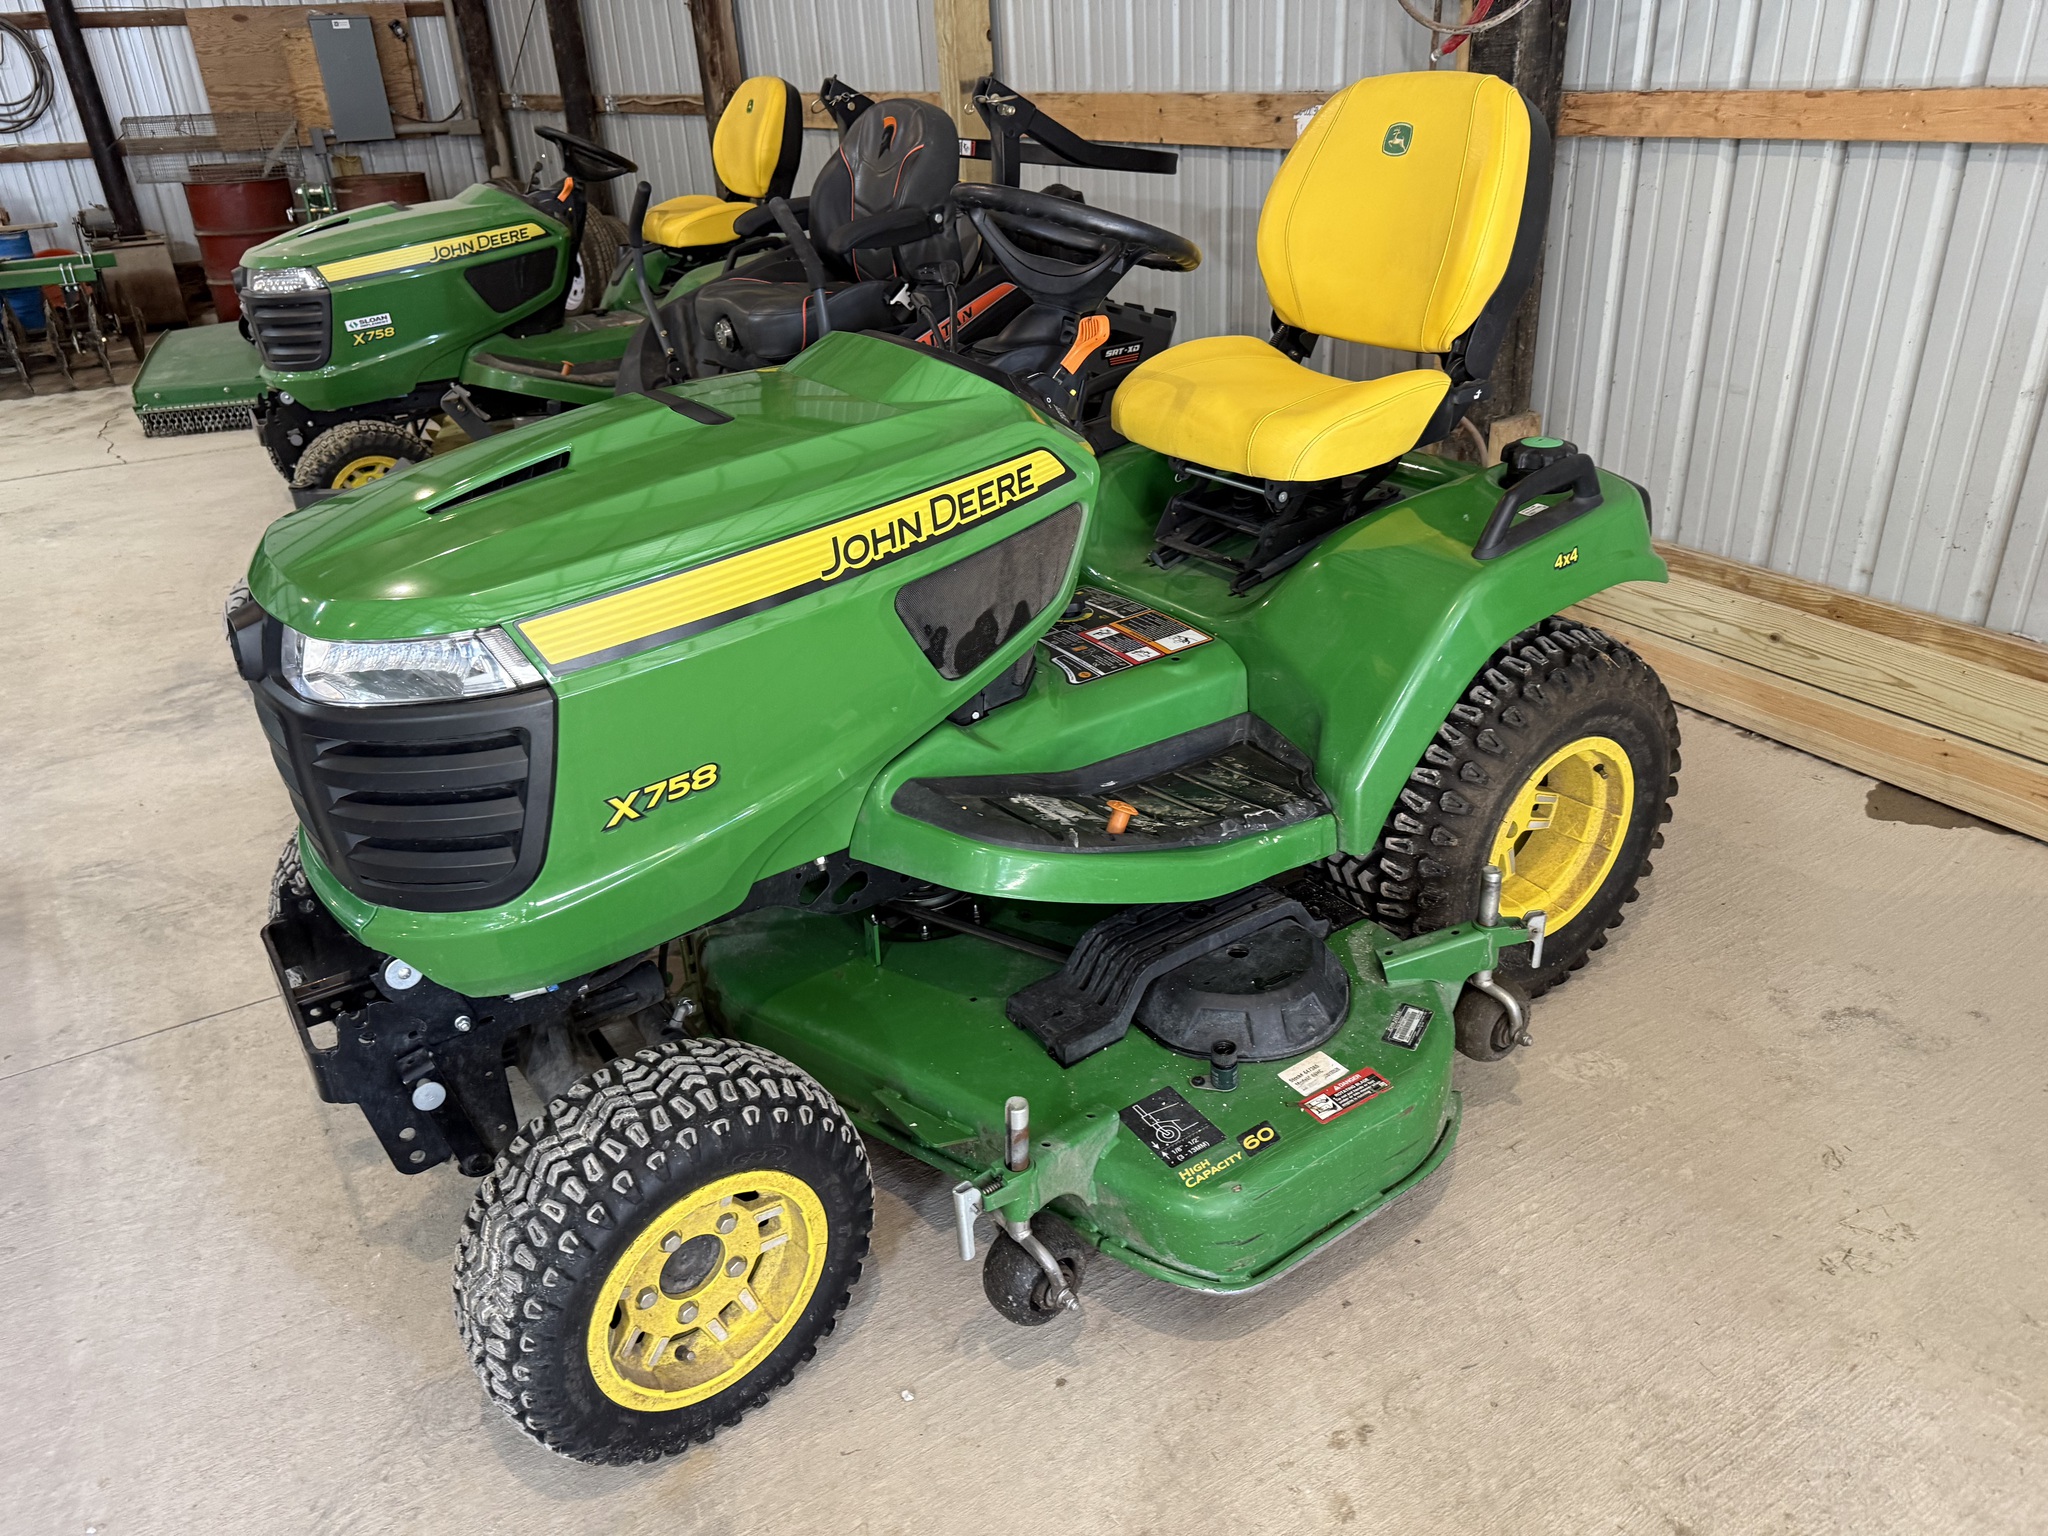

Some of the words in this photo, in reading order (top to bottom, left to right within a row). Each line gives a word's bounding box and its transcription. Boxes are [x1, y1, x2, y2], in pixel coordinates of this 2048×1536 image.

[430, 241, 475, 262] JOHN
[477, 227, 530, 249] DEERE
[358, 314, 388, 324] SLOAN
[353, 327, 395, 346] X758
[821, 510, 922, 577] JOHN
[929, 463, 1035, 531] DEERE
[1554, 547, 1578, 569] 4x4
[601, 762, 720, 832] X758
[1338, 1073, 1362, 1087] DANGER
[1242, 1126, 1276, 1150] 60
[1178, 1158, 1212, 1181] HIGH
[1185, 1151, 1243, 1188] CAPACITY
